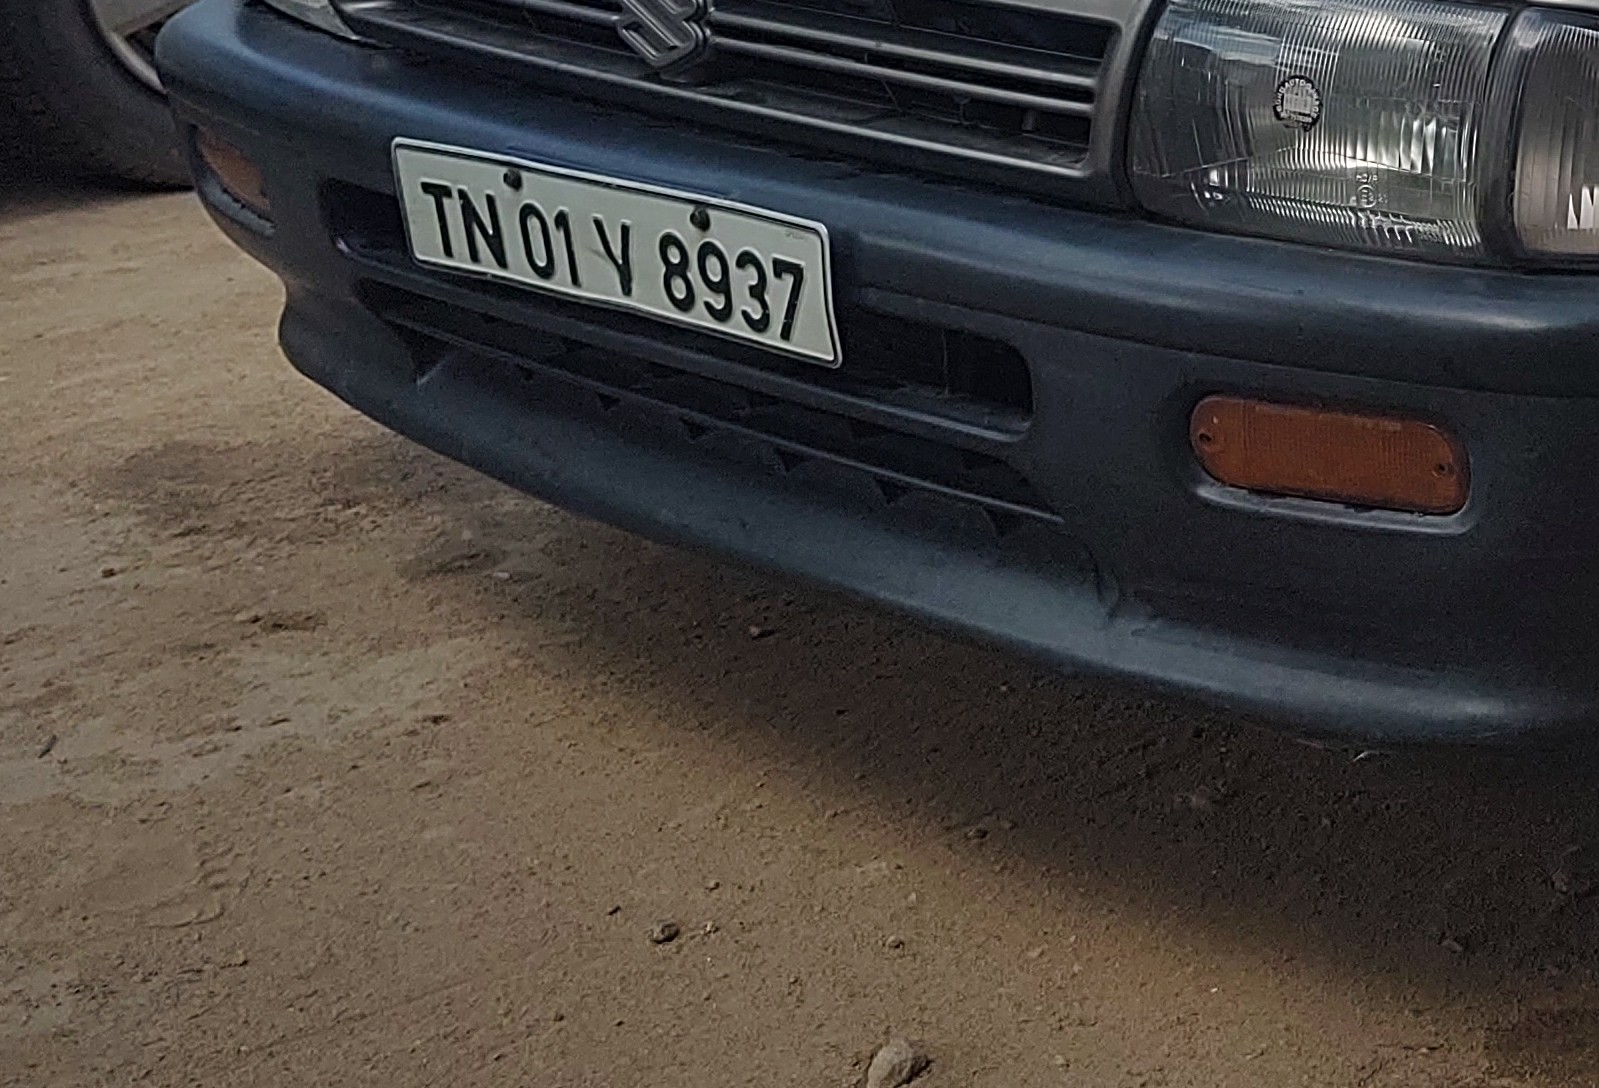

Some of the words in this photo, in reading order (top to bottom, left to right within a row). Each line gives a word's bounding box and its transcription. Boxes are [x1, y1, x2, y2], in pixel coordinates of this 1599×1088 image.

[421, 181, 508, 270] TN
[518, 202, 582, 288] 01
[593, 215, 632, 297] Y
[658, 231, 805, 342] 8937
